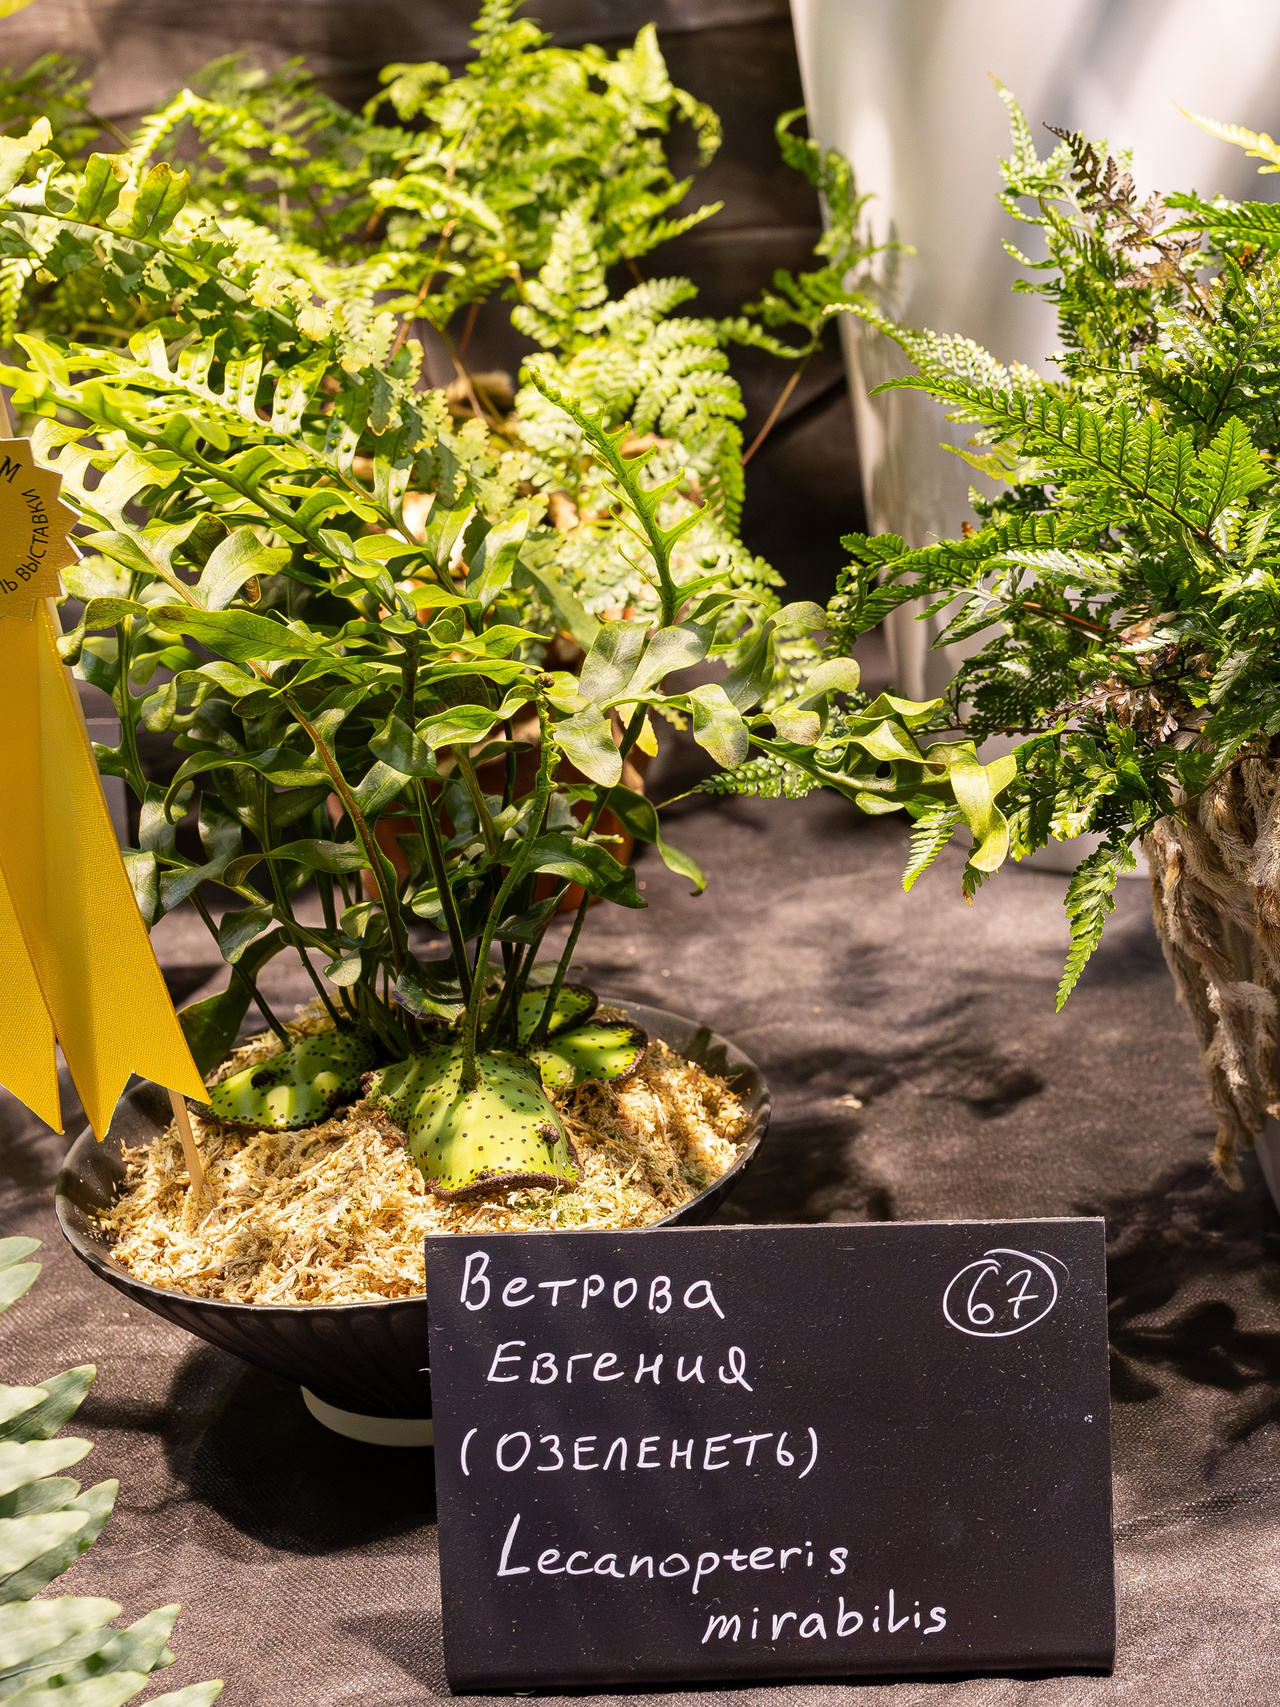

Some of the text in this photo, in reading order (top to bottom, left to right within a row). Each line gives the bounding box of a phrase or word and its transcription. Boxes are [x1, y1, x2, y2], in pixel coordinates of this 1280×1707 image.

[15, 488, 49, 582] ВЫСТАВКИ
[460, 1250, 726, 1320] Ветрова
[965, 1265, 1039, 1325] 67
[486, 1340, 754, 1392] Евгения
[496, 1513, 849, 1595] Lecanopteris
[701, 1588, 947, 1644] mirabilis
